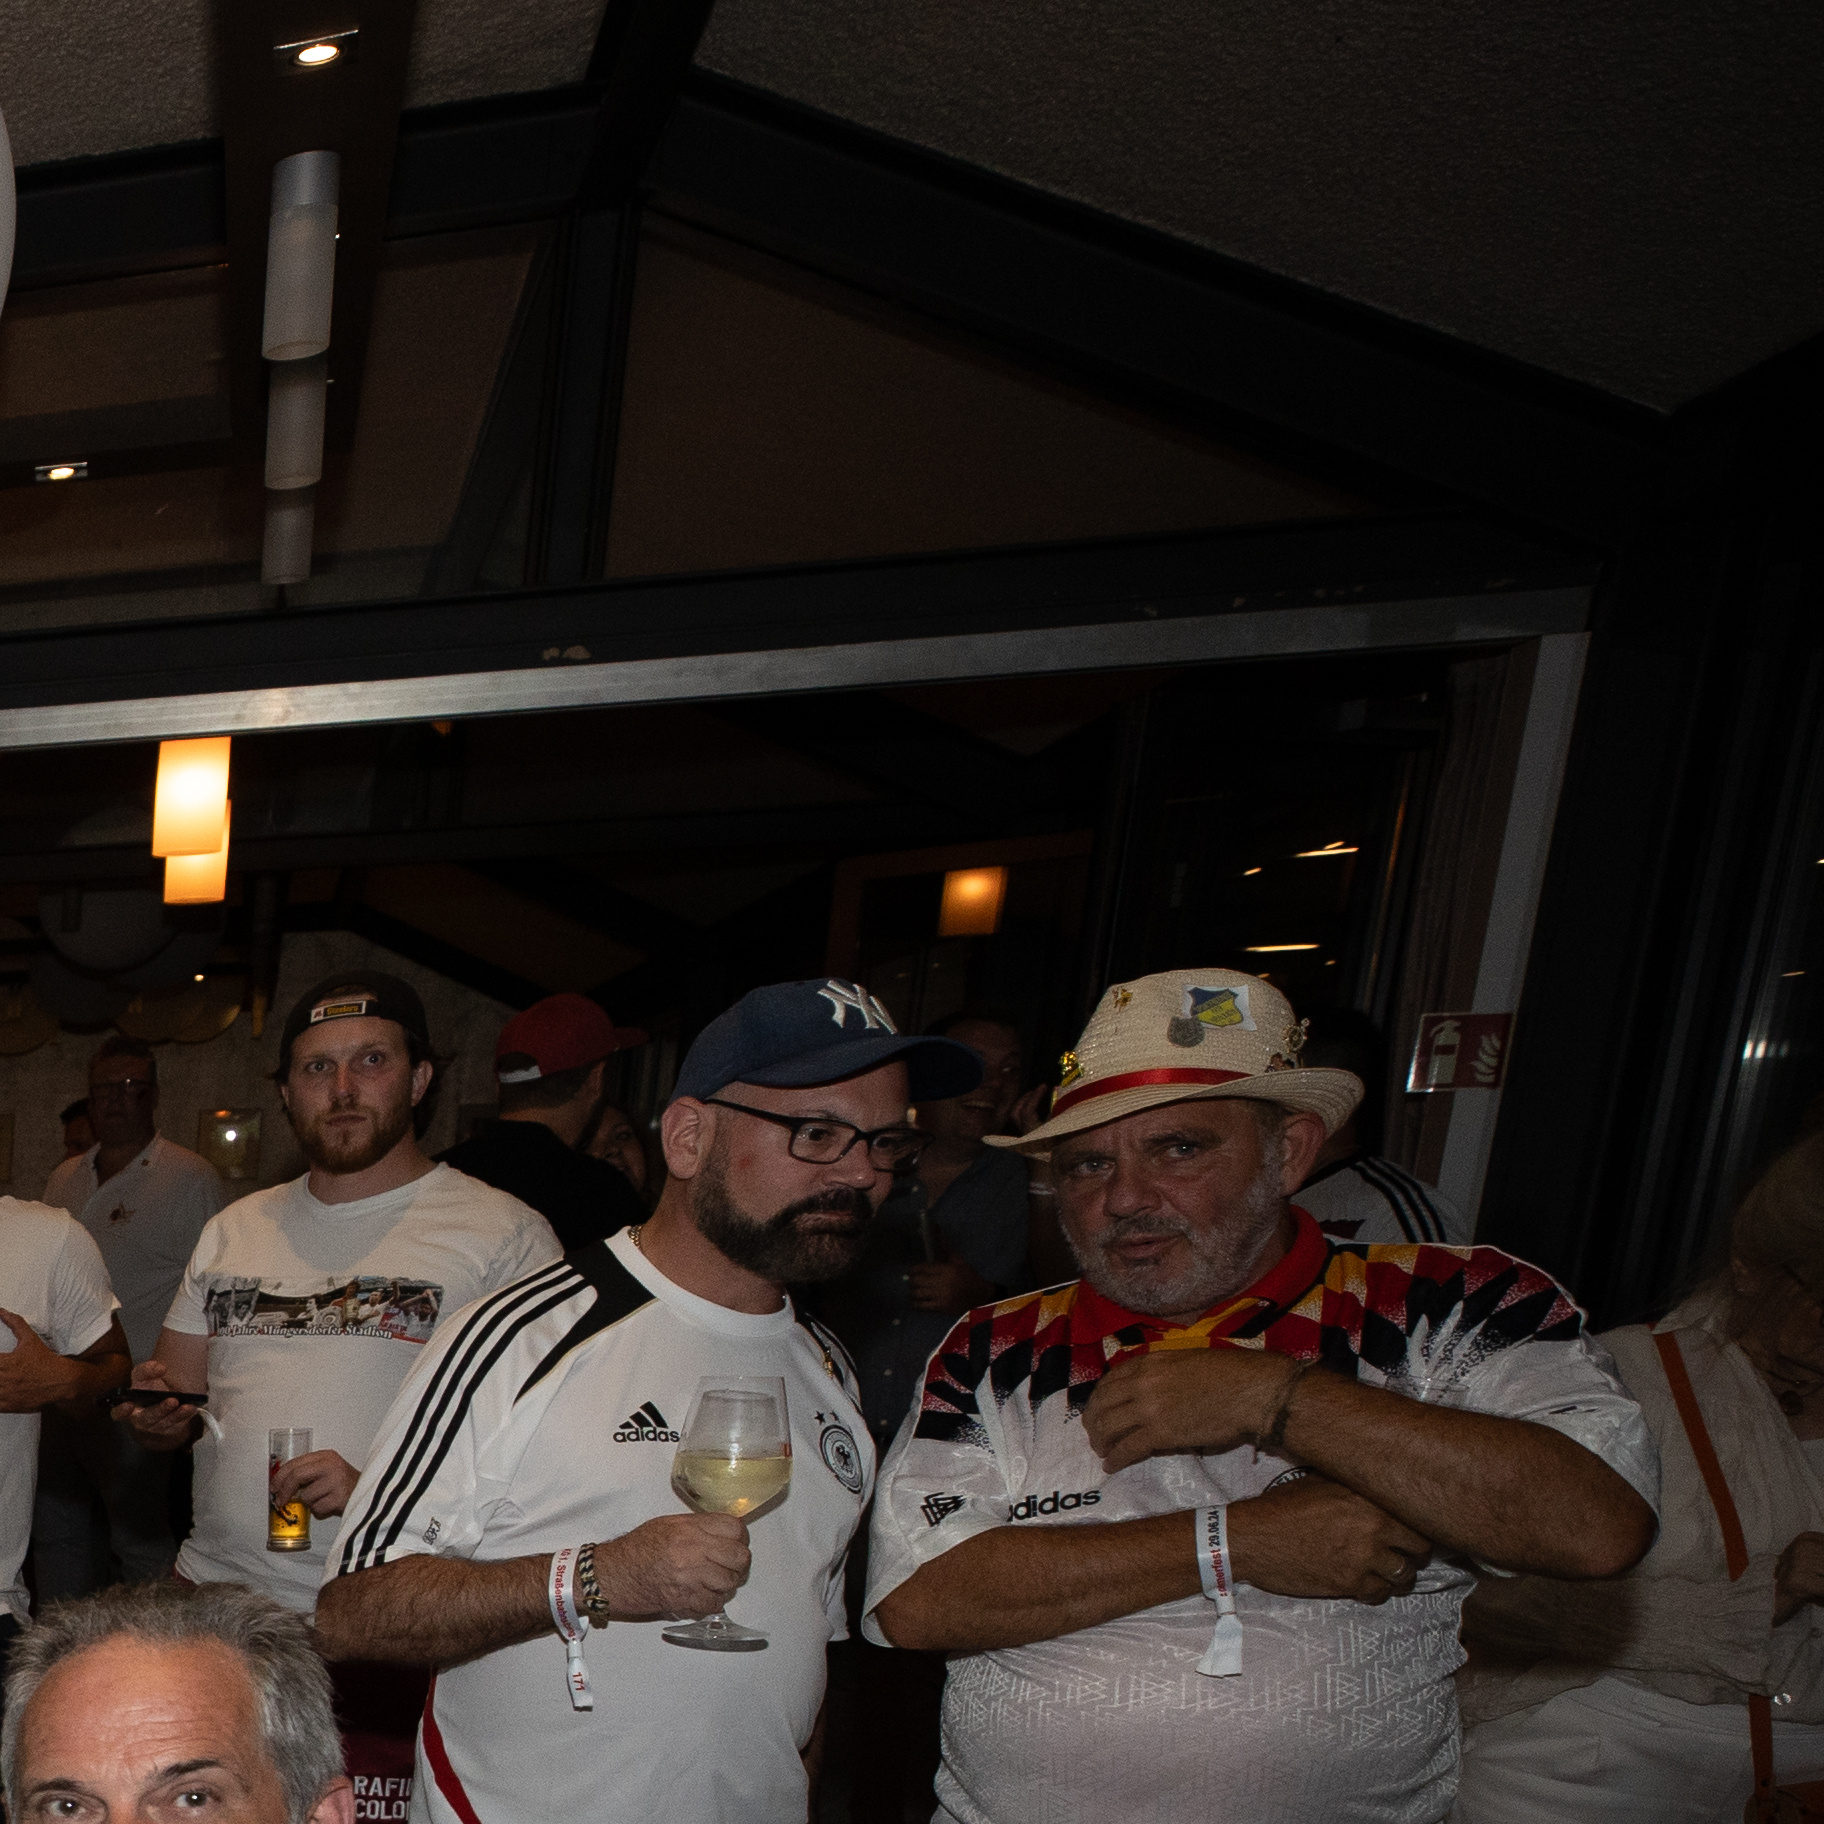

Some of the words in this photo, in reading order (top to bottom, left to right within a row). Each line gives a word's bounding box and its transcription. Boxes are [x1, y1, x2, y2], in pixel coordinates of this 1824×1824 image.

[344, 1320, 393, 1339] Stadion
[613, 1425, 680, 1443] adidas
[354, 1775, 412, 1797] RAFI
[354, 1798, 411, 1821] COLO
